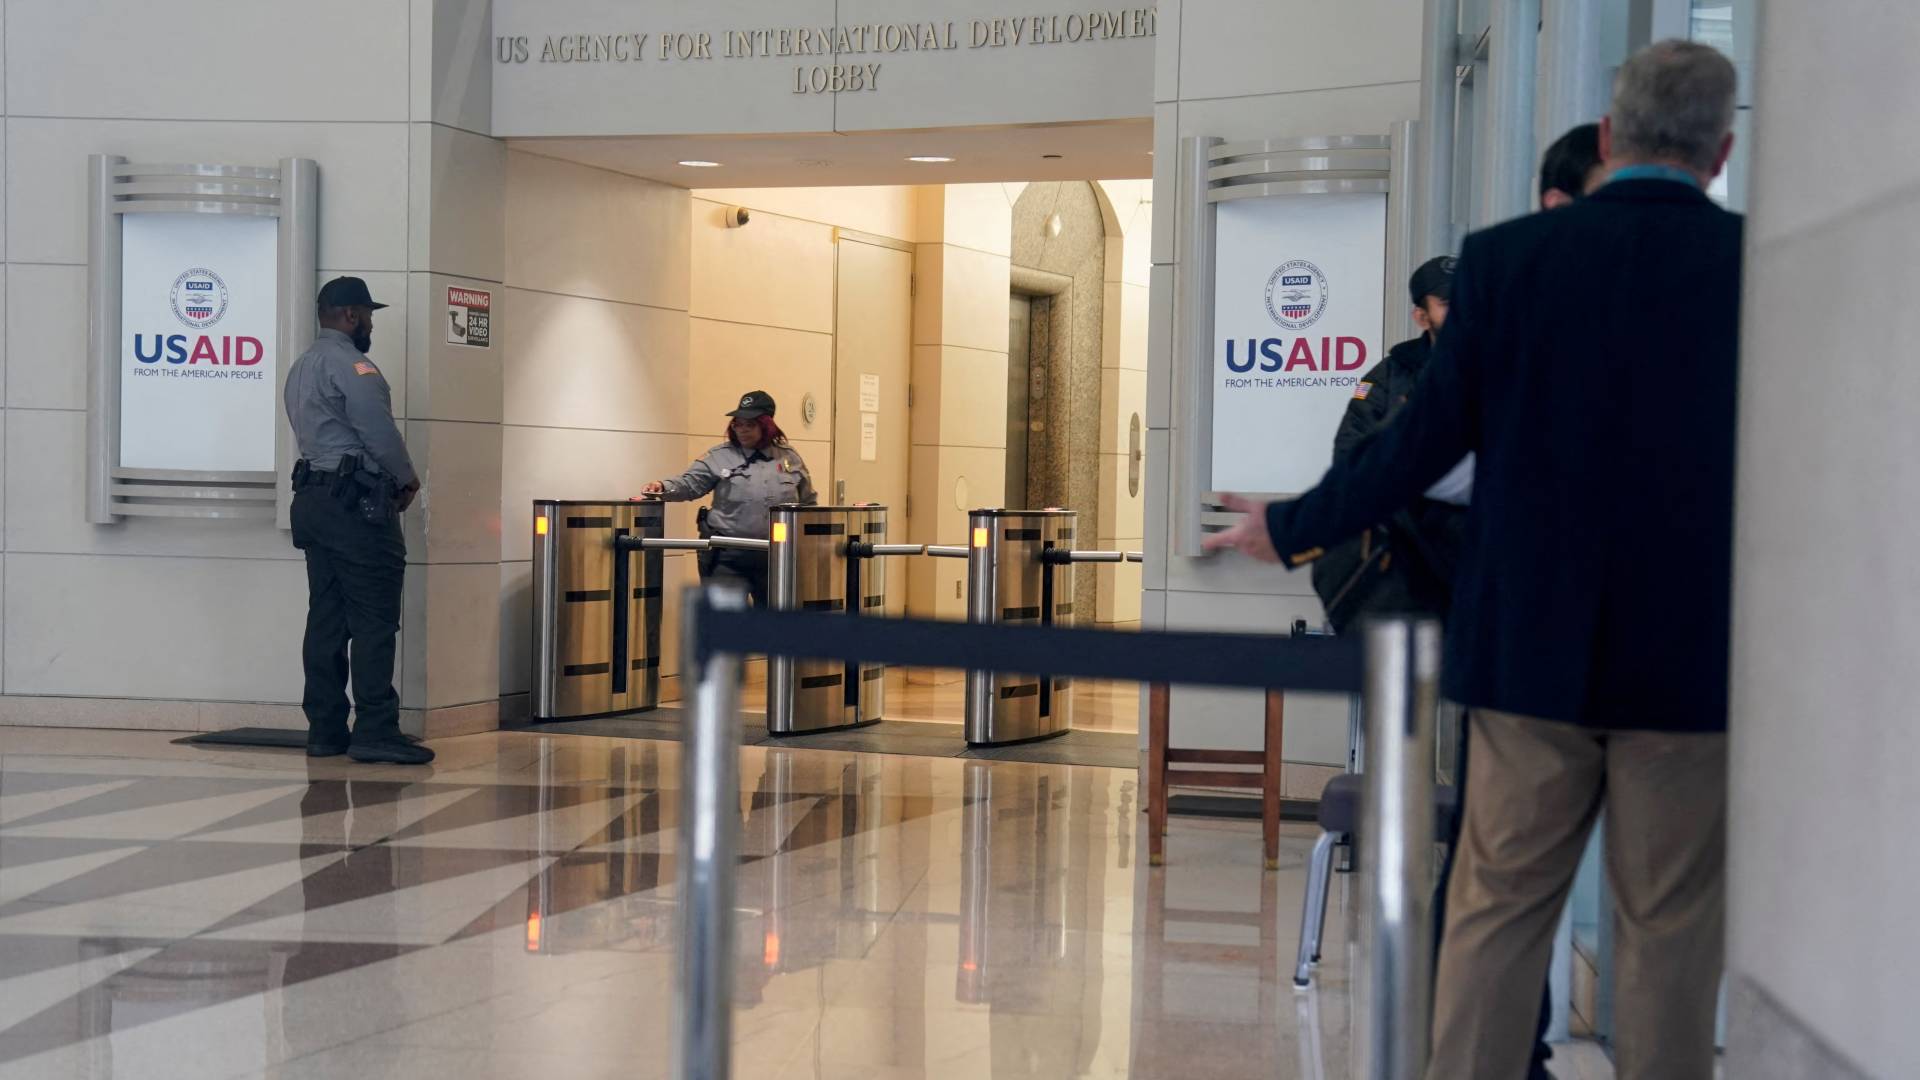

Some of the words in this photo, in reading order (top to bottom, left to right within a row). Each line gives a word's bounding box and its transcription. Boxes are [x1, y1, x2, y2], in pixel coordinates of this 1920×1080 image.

[497, 36, 529, 63] US
[539, 33, 648, 63] AGENCY
[658, 31, 711, 60] FOR
[723, 20, 957, 58] INTERNATIONAL
[968, 7, 1158, 49] DEVELOPMEN
[792, 63, 881, 94] LOBBY
[450, 290, 489, 306] WARNING
[469, 316, 478, 326] 24
[478, 317, 488, 328] HR
[468, 326, 488, 337] VIDEO
[134, 333, 263, 366] USAID
[1226, 336, 1367, 373] USAID
[134, 368, 159, 377] FROM
[161, 369, 179, 377] THE
[181, 369, 228, 379] AMERICAN
[231, 371, 263, 380] PEOPLE
[1225, 378, 1251, 388] FROM
[1254, 378, 1273, 388] THE
[1276, 376, 1327, 388] AMERICAN
[1330, 376, 1360, 387] PEOPL
